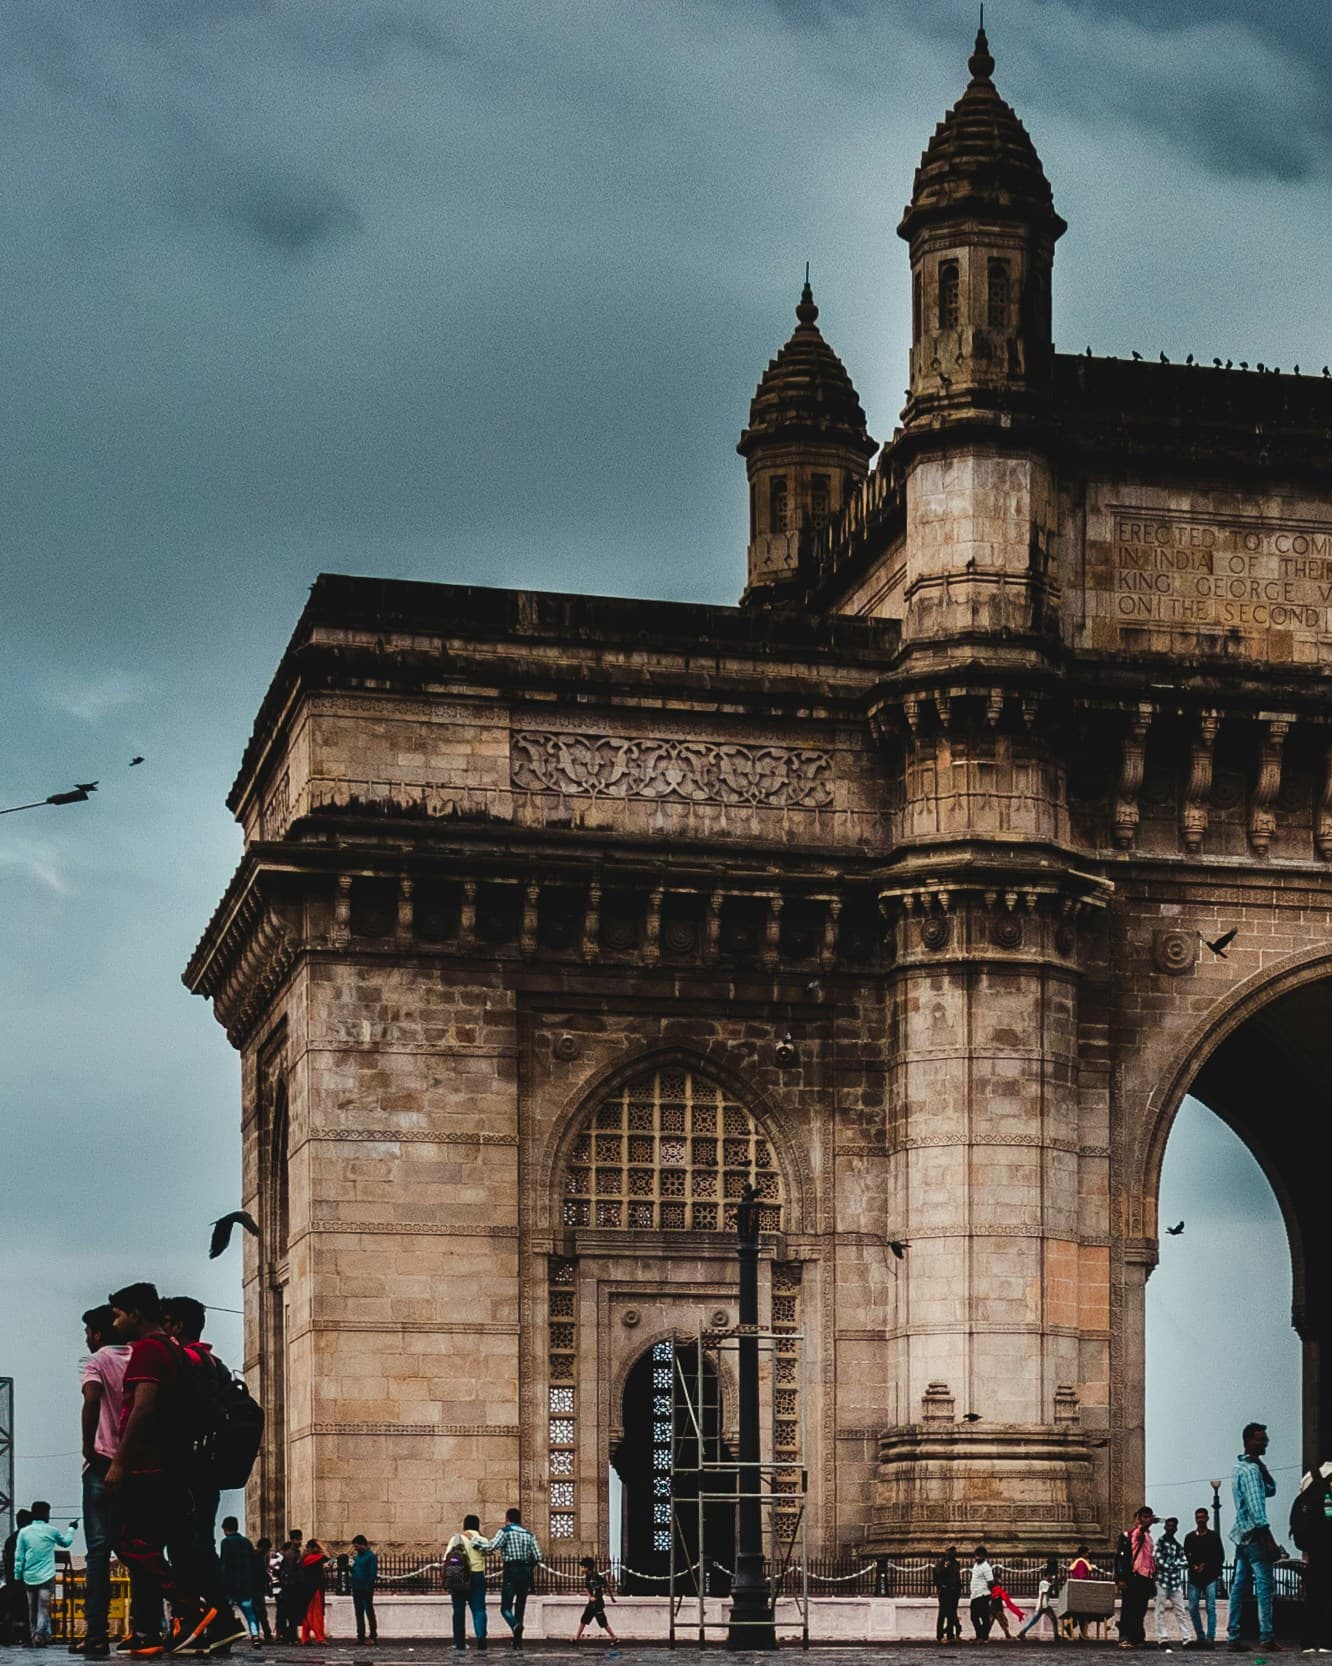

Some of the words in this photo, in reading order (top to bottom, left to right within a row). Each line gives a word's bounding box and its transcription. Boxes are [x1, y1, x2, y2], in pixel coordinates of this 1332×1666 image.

[1119, 523, 1215, 548] ERECTED
[1229, 531, 1260, 551] TO
[1119, 547, 1139, 566] IN
[1154, 549, 1211, 571] INDIA
[1228, 555, 1258, 575] OF
[1119, 571, 1171, 593] KING
[1196, 577, 1295, 602] GEORGE
[1118, 596, 1152, 615] ON
[1168, 599, 1206, 620] THE
[1223, 603, 1319, 627] SECOND
